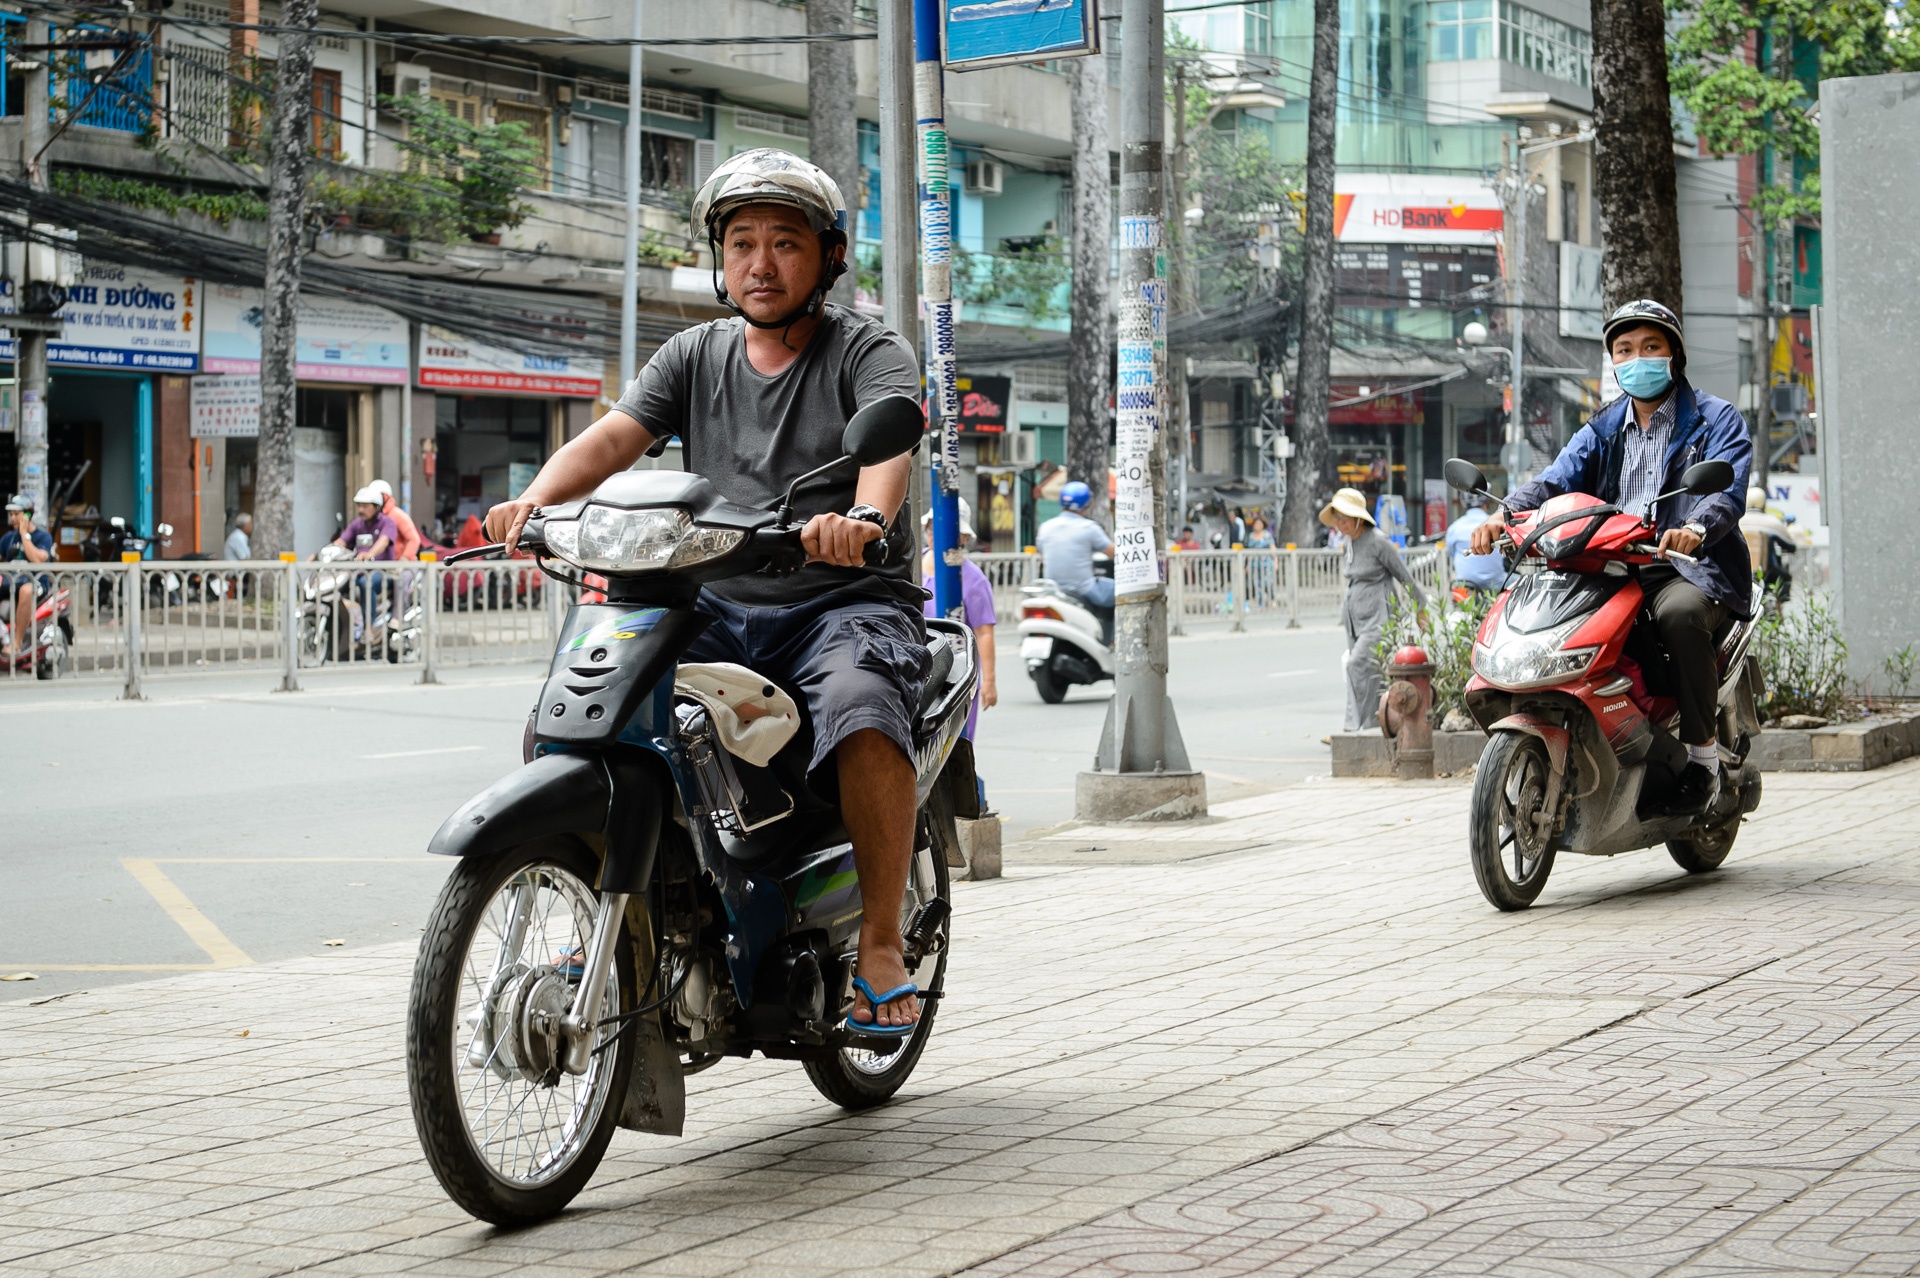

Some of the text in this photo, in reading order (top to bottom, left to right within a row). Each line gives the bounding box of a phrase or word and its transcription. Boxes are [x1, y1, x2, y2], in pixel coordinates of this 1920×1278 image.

[1373, 208, 1449, 227] HDBank
[105, 282, 176, 310] ĐƯỜNG
[936, 303, 955, 355] 39800984
[1122, 546, 1151, 564] XÂY
[1603, 700, 1628, 713] HONDA
